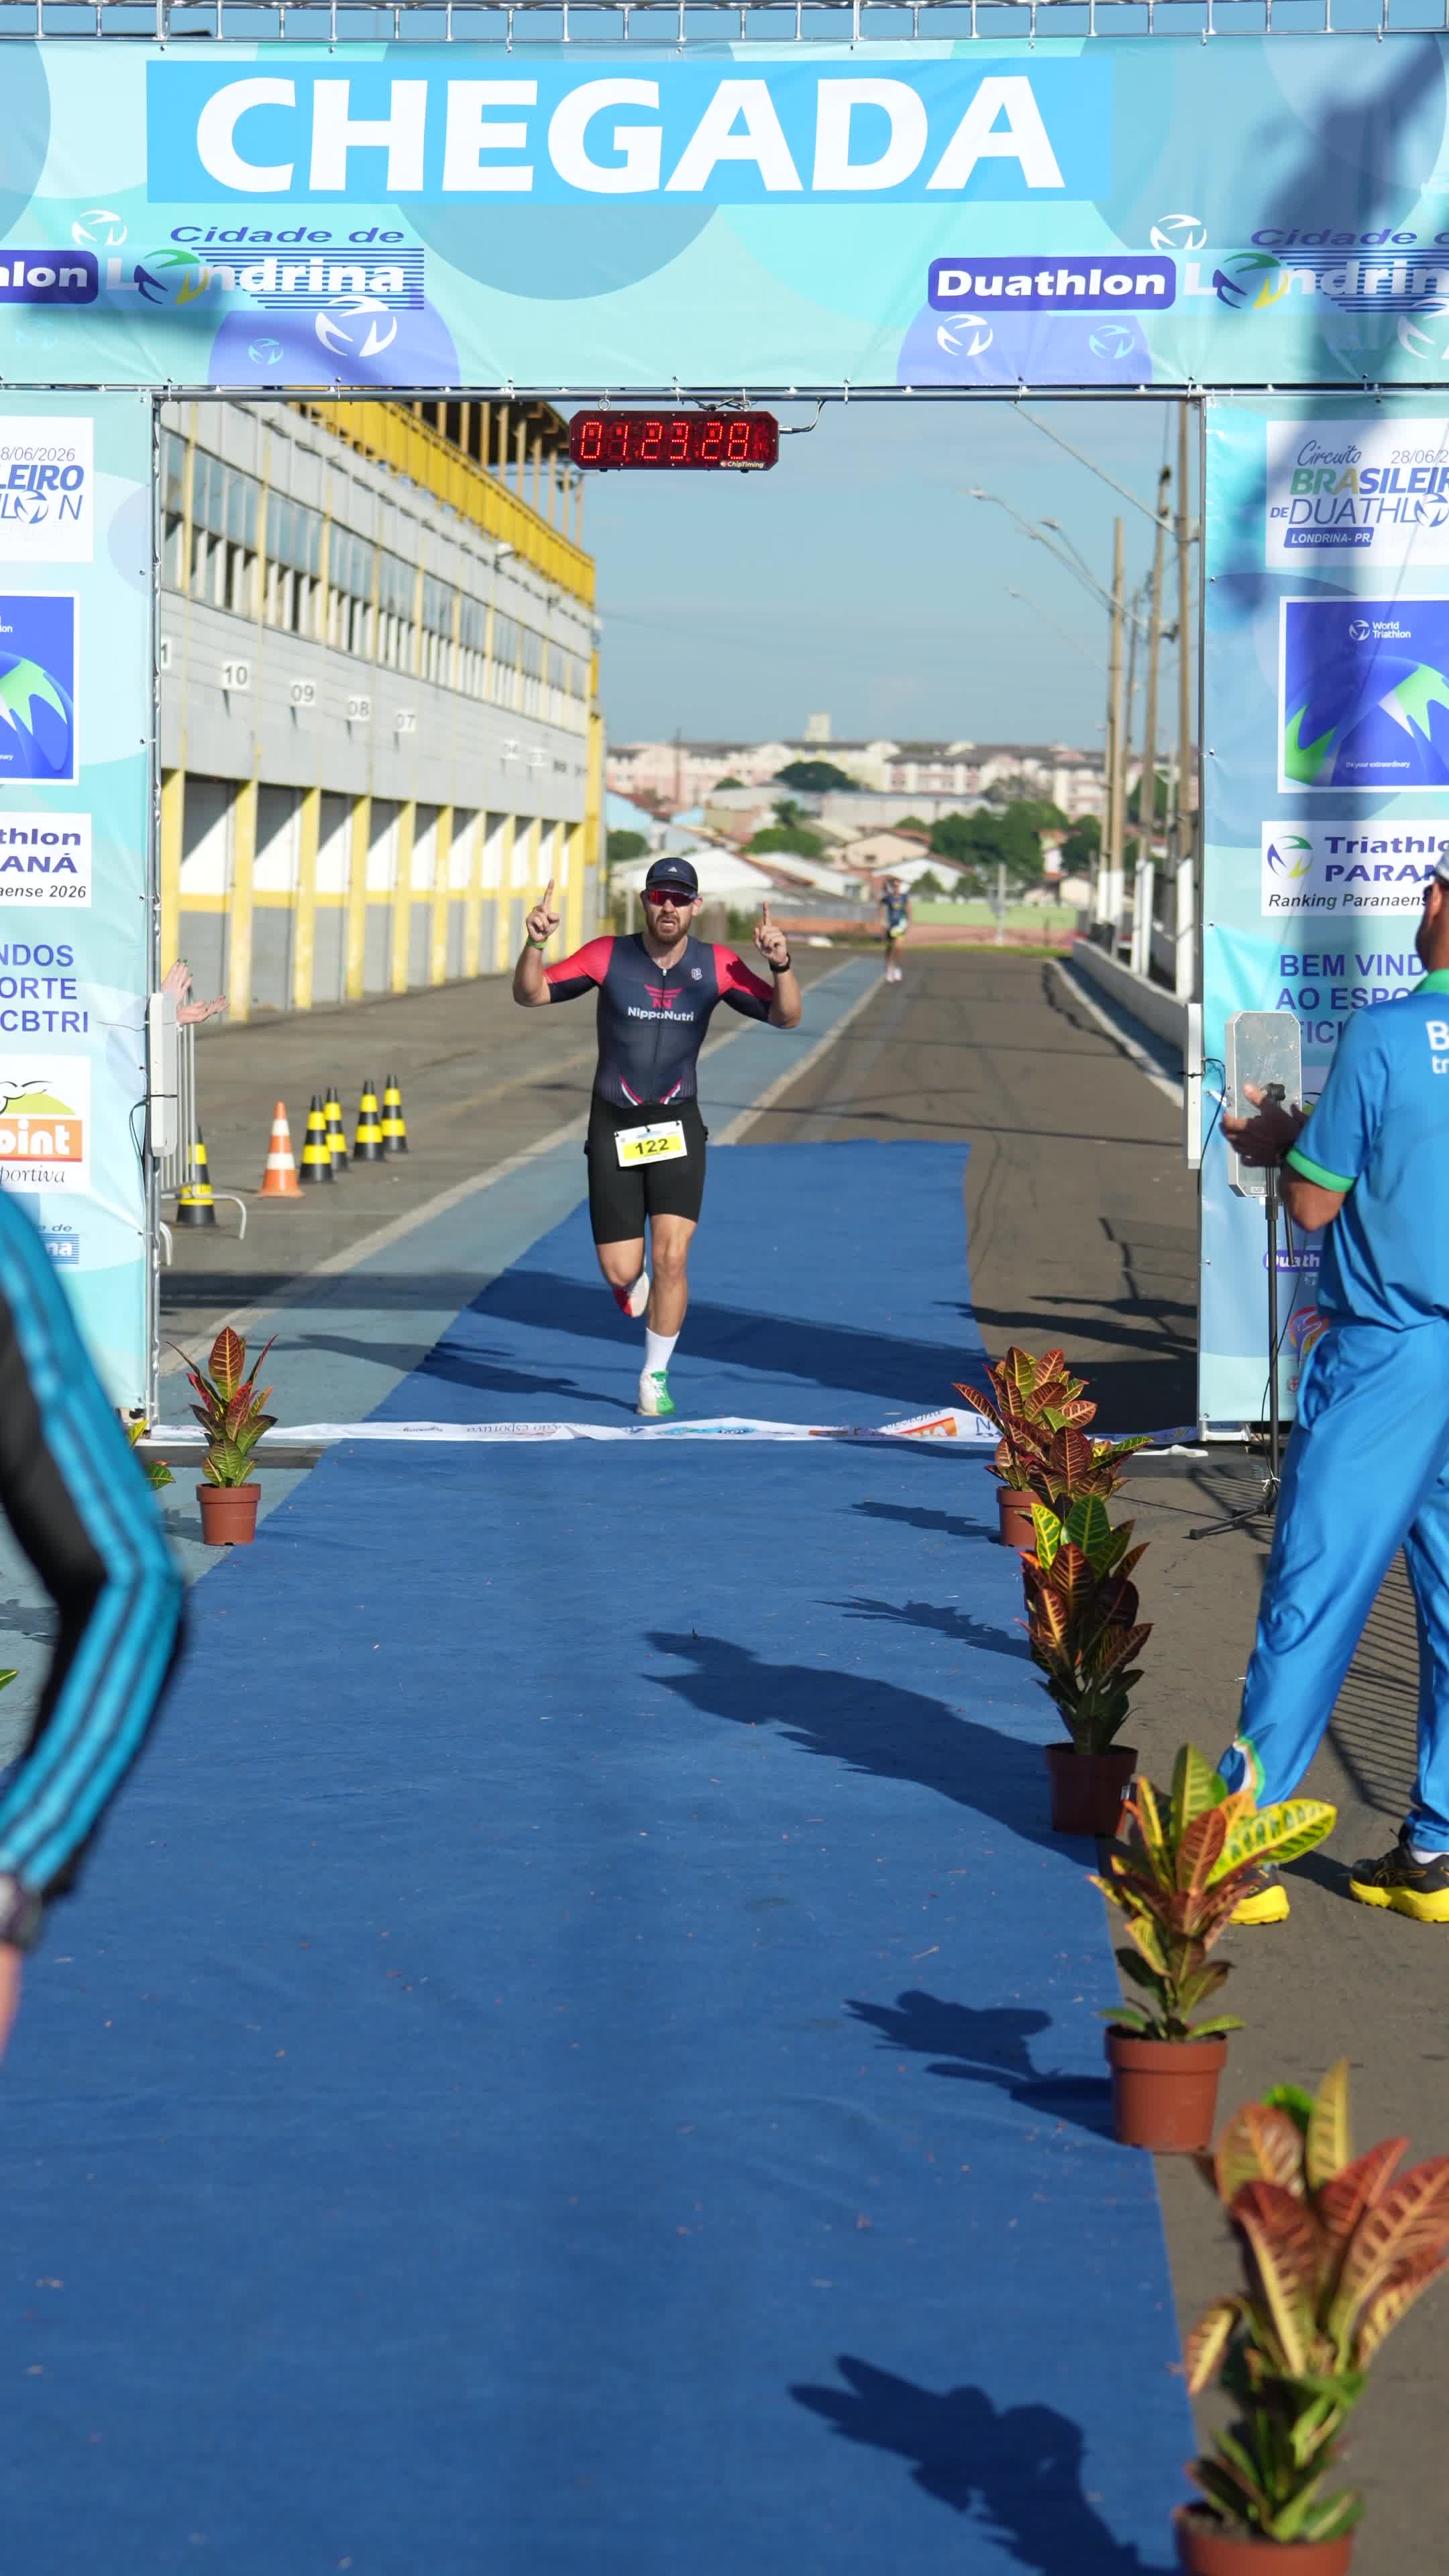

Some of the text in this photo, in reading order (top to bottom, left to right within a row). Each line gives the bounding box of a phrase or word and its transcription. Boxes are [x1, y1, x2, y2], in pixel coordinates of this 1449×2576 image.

[196, 76, 1065, 193] CHEGADA
[170, 226, 404, 243] Cidade de
[1251, 229, 1417, 246] Cidade
[937, 268, 1166, 297] Duathlon
[1297, 440, 1361, 466] Circuito
[0, 465, 84, 491] EIRO
[1270, 507, 1289, 519] DE
[1373, 621, 1399, 630] World
[1373, 630, 1411, 638] Triathlon
[225, 665, 248, 686] 10
[290, 685, 315, 702] 09
[348, 700, 370, 717] 08
[49, 885, 87, 898] 2026
[1269, 894, 1337, 910] Ranking
[1280, 954, 1344, 977] BEM
[0, 976, 77, 1000] ORTE
[1276, 987, 1320, 1011] AO
[0, 1010, 88, 1032] CBTRI
[627, 1006, 694, 1021] NippoNutri
[635, 1138, 669, 1155] 122
